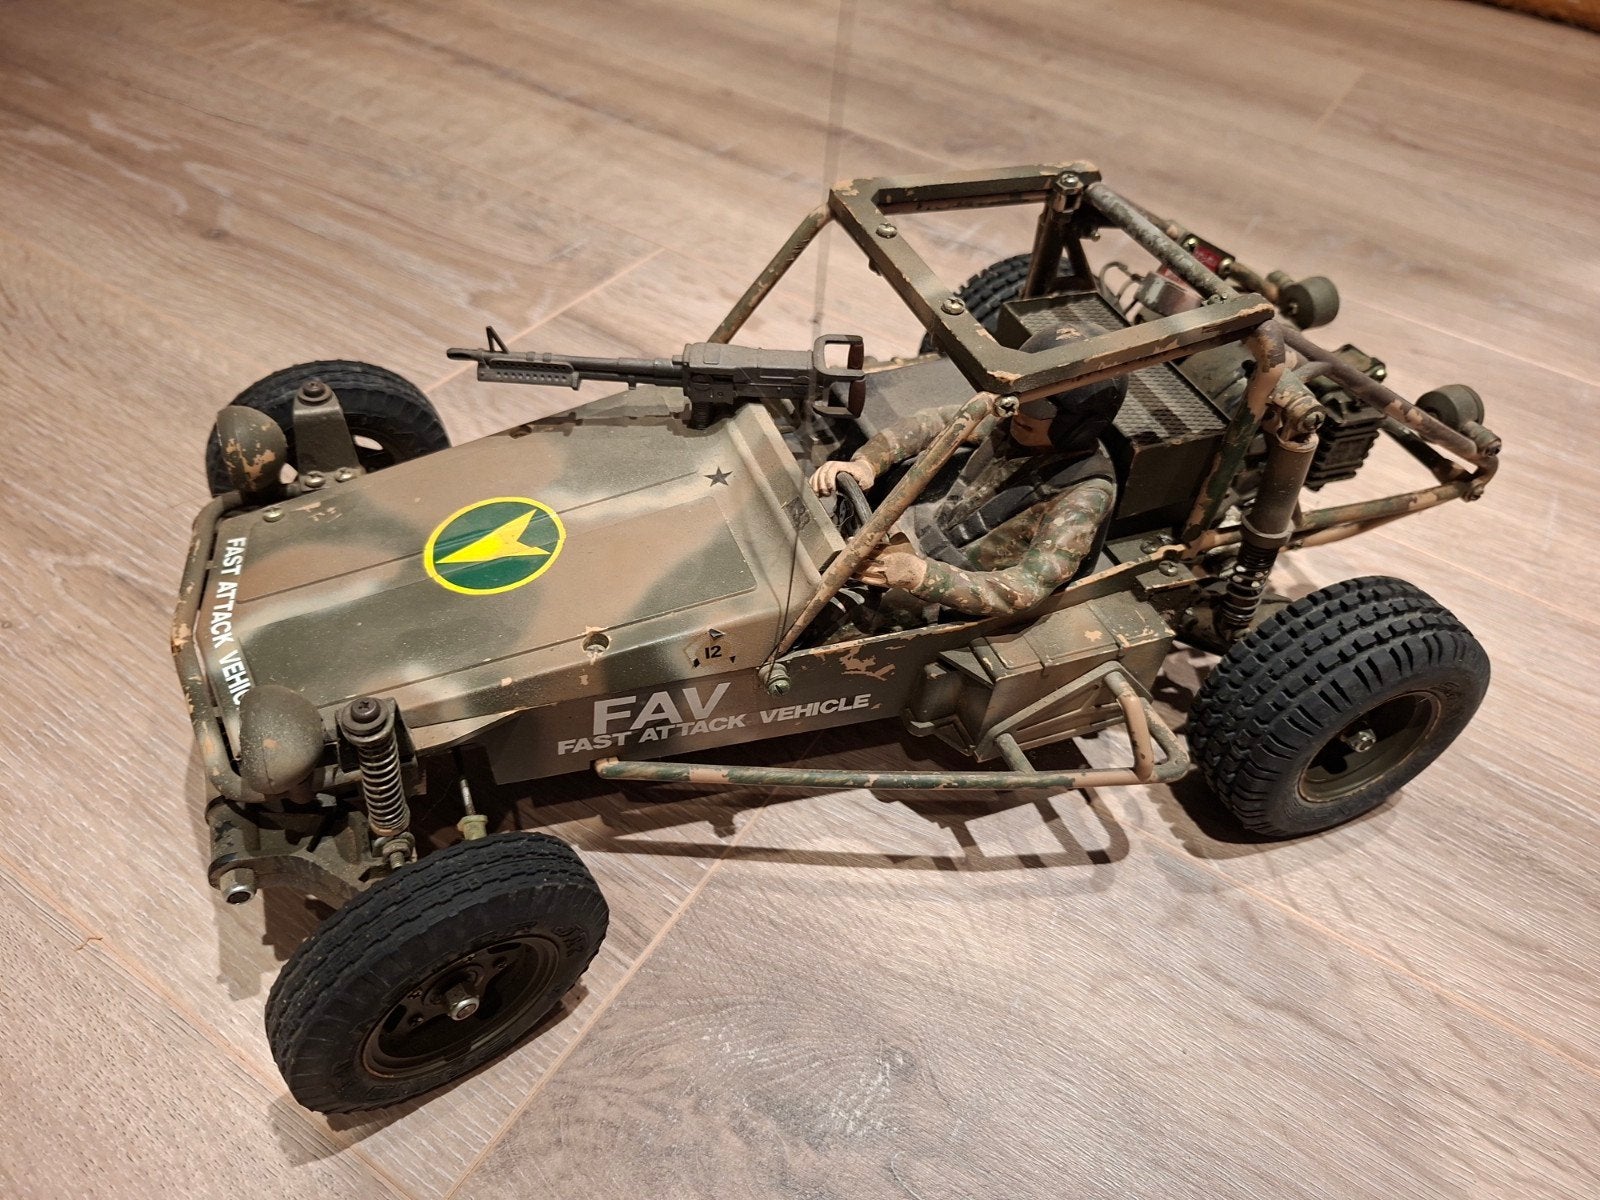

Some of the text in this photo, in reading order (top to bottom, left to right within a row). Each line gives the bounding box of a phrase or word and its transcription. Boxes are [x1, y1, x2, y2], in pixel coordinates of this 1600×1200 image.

[210, 536, 251, 706] FAST ATTACK VEHIC
[704, 645, 722, 659] 12
[557, 693, 871, 755] FAST ATTACK VEHICLE
[593, 682, 731, 735] FAV
